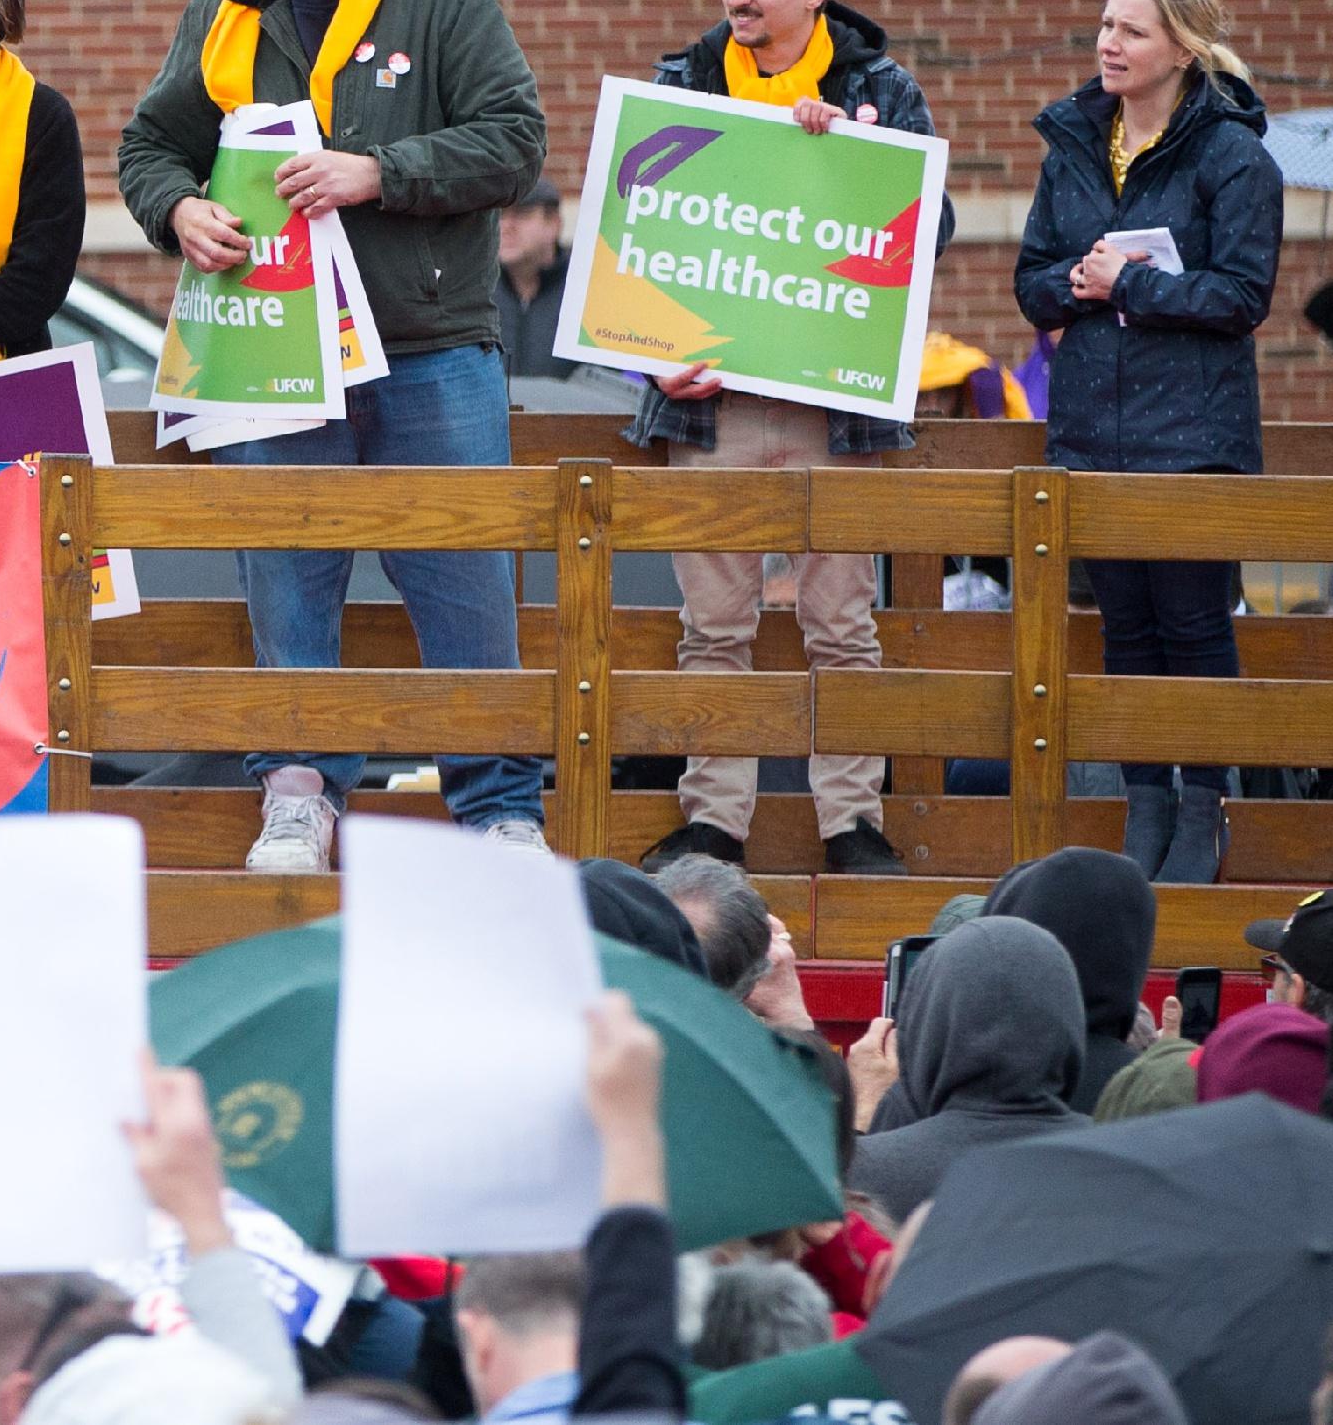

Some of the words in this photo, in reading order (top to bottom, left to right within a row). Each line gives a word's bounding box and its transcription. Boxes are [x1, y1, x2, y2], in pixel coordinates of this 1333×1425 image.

[624, 183, 806, 244] protect
[813, 218, 893, 261] our
[249, 233, 290, 266] ur
[615, 231, 871, 320] healthcare
[176, 279, 285, 328] ealthcare
[594, 327, 676, 352] #StopAndShop
[272, 378, 315, 393] UFCW
[836, 367, 886, 391] UFCW
